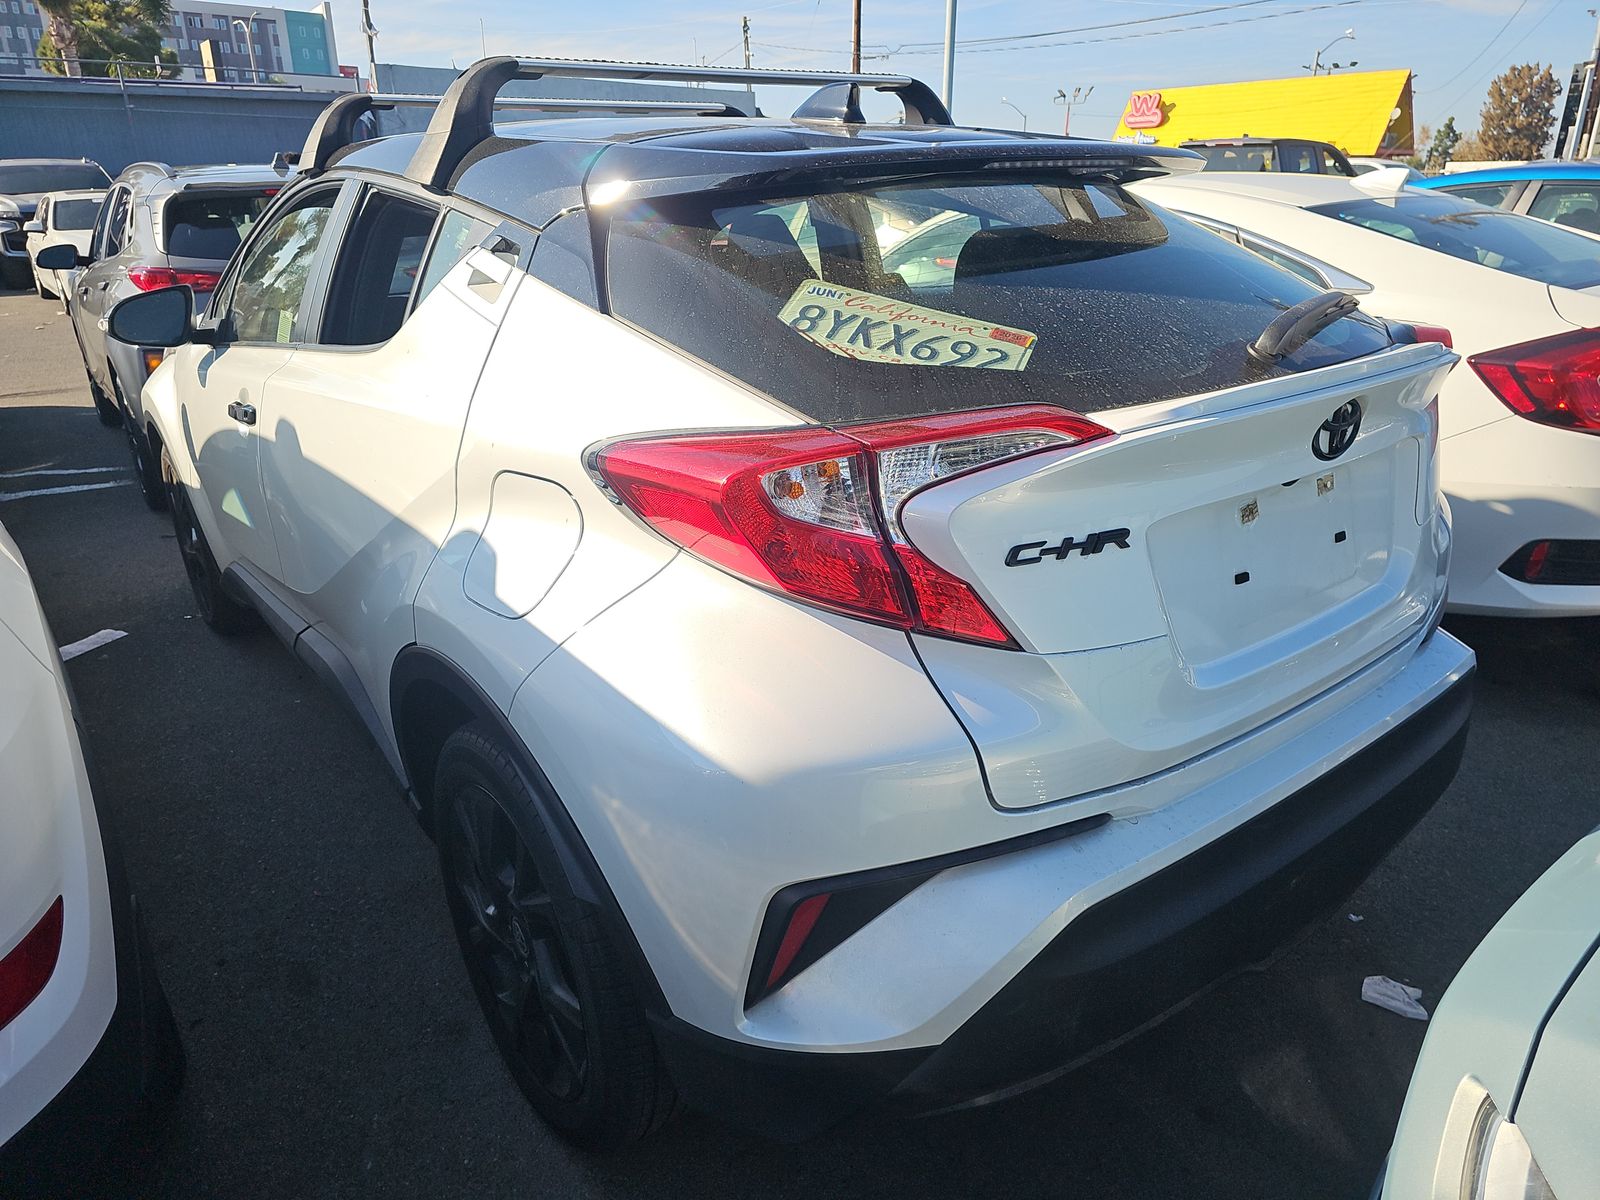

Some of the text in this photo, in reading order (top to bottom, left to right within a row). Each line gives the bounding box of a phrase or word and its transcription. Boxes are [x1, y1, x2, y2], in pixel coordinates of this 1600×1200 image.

[789, 304, 1009, 369] 8YKX692
[844, 296, 990, 339] California
[1004, 527, 1131, 567] C-HR
